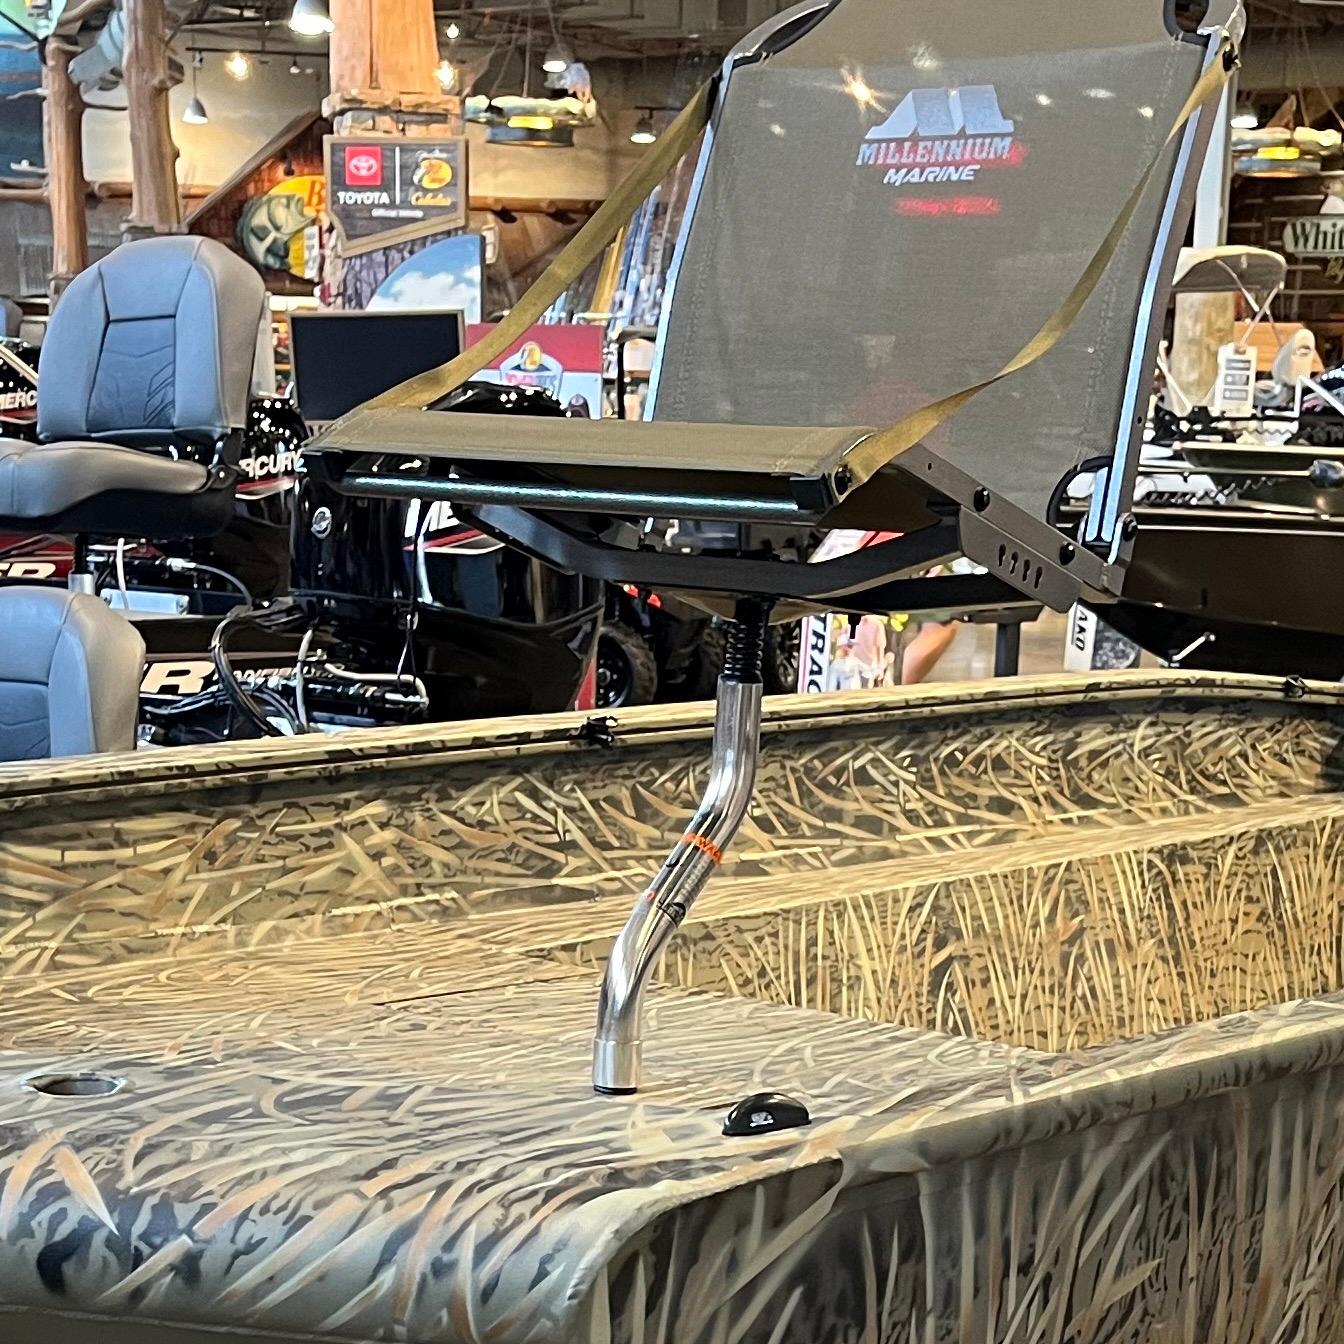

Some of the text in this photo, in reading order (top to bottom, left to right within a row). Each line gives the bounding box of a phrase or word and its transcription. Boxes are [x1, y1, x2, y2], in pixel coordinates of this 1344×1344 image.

[856, 136, 1014, 166] MILLENNIUM
[883, 164, 981, 187] MARINE
[336, 191, 390, 205] TOYOTA
